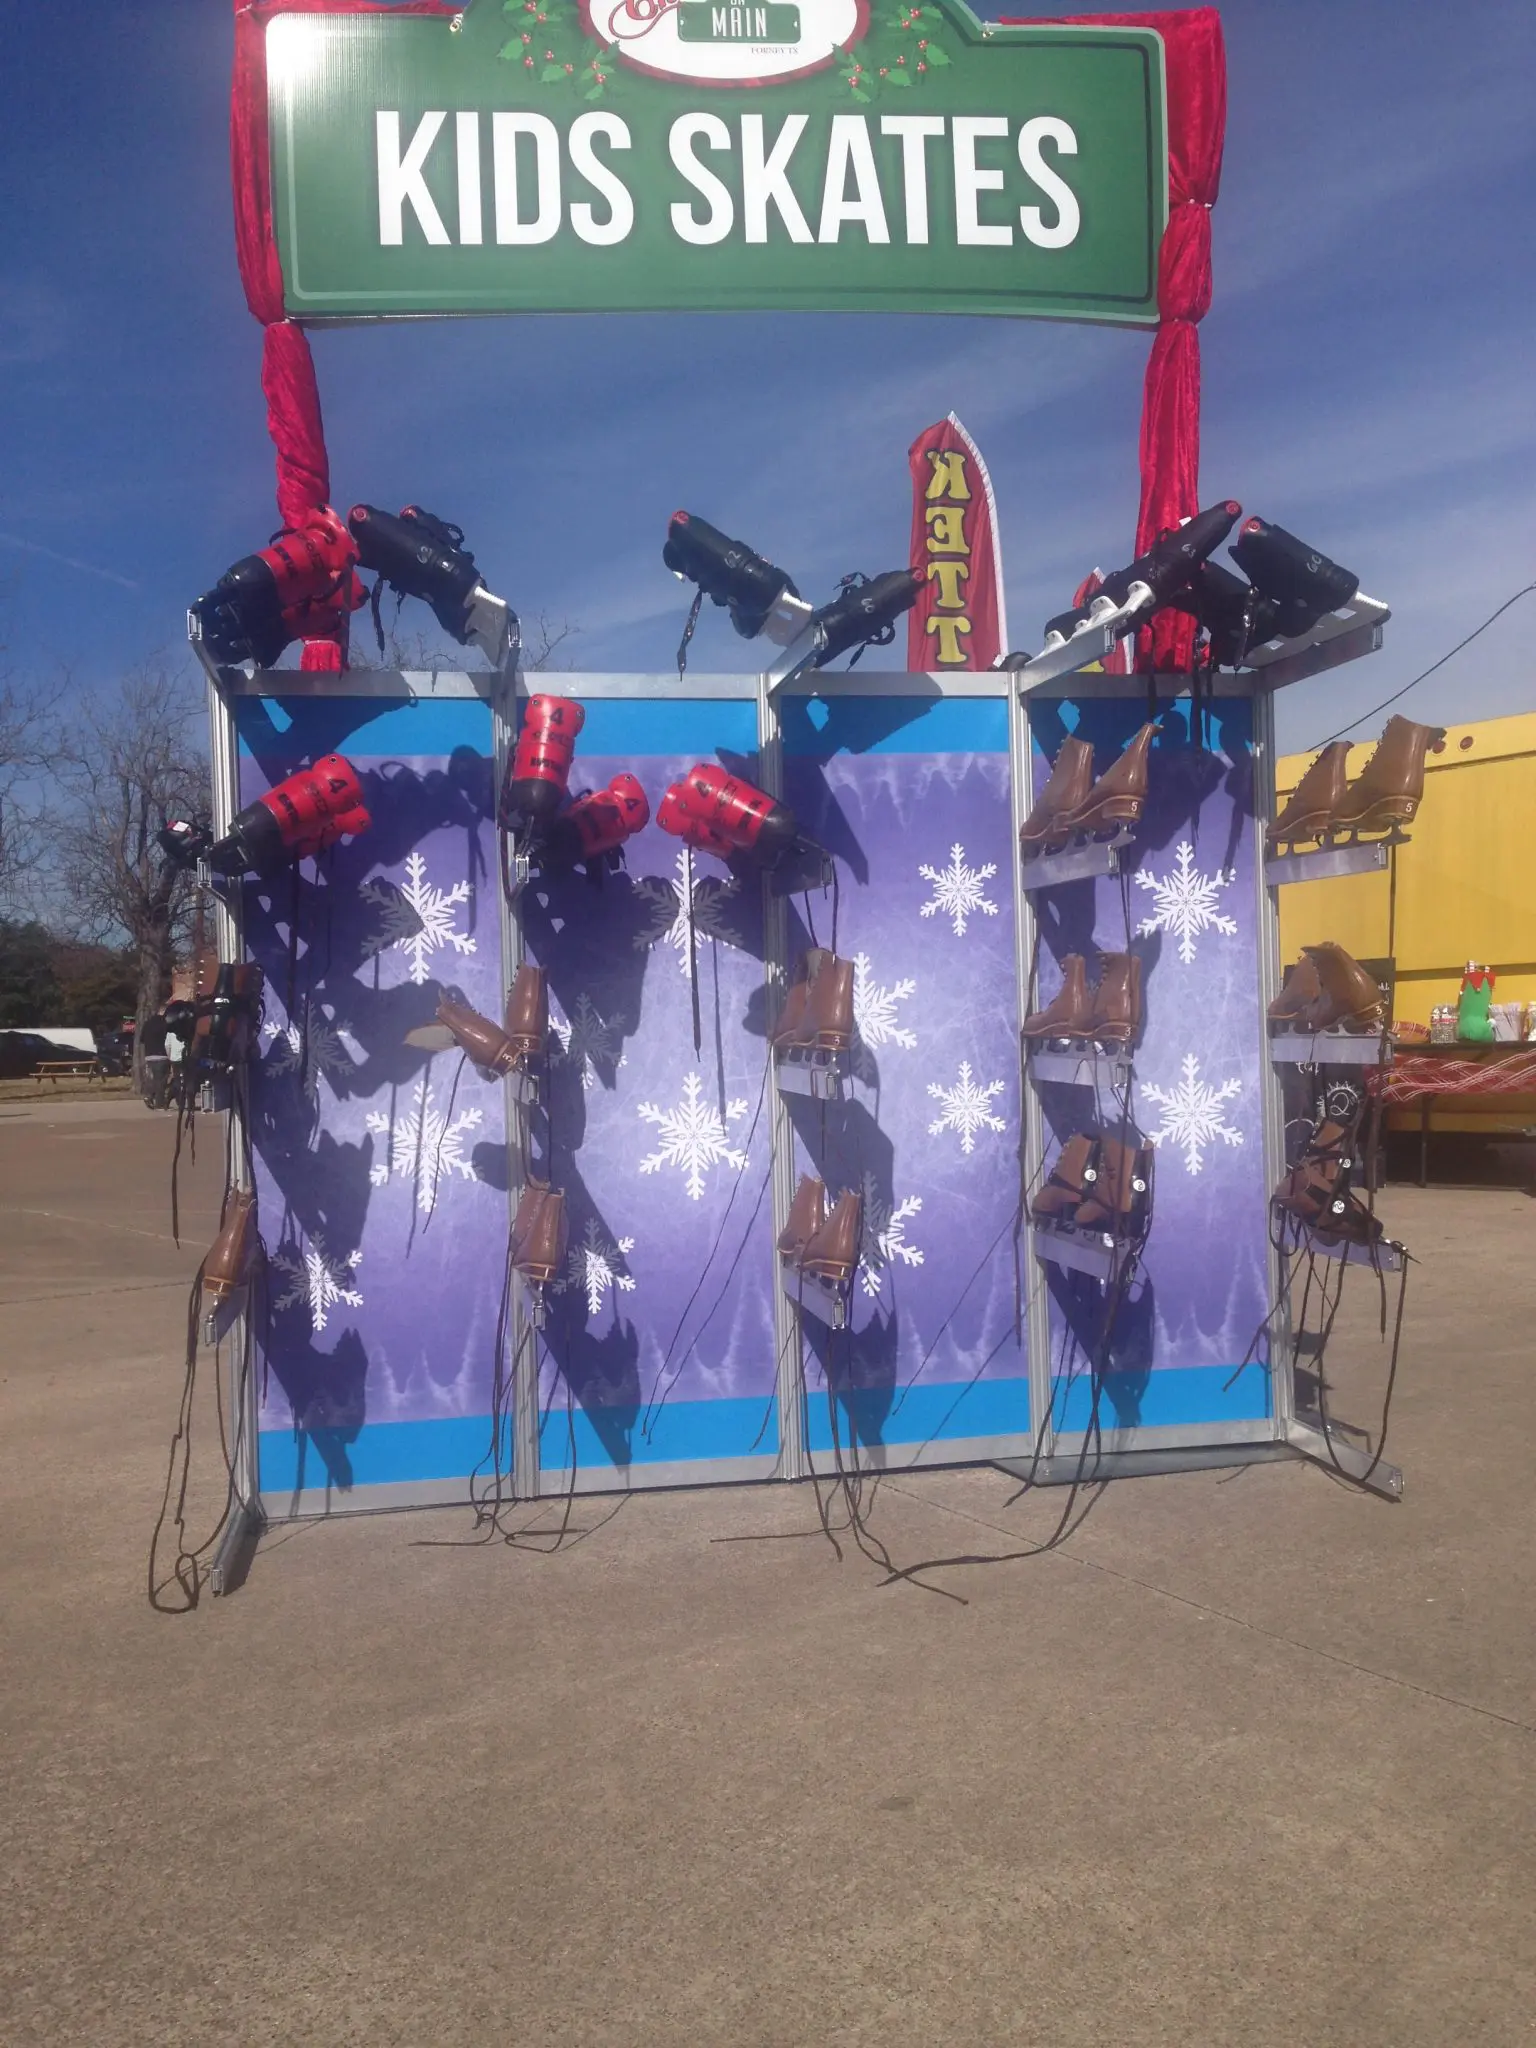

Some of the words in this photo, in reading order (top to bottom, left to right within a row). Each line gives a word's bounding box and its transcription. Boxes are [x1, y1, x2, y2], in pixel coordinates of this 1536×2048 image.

[711, 7, 768, 37] MAIN
[375, 110, 634, 246] KIDS
[668, 112, 1081, 249] SKATES
[549, 707, 563, 725] 4
[328, 778, 348, 795] 4
[1131, 801, 1138, 812] 5
[1405, 802, 1413, 813] 5
[1375, 1005, 1383, 1015] 3
